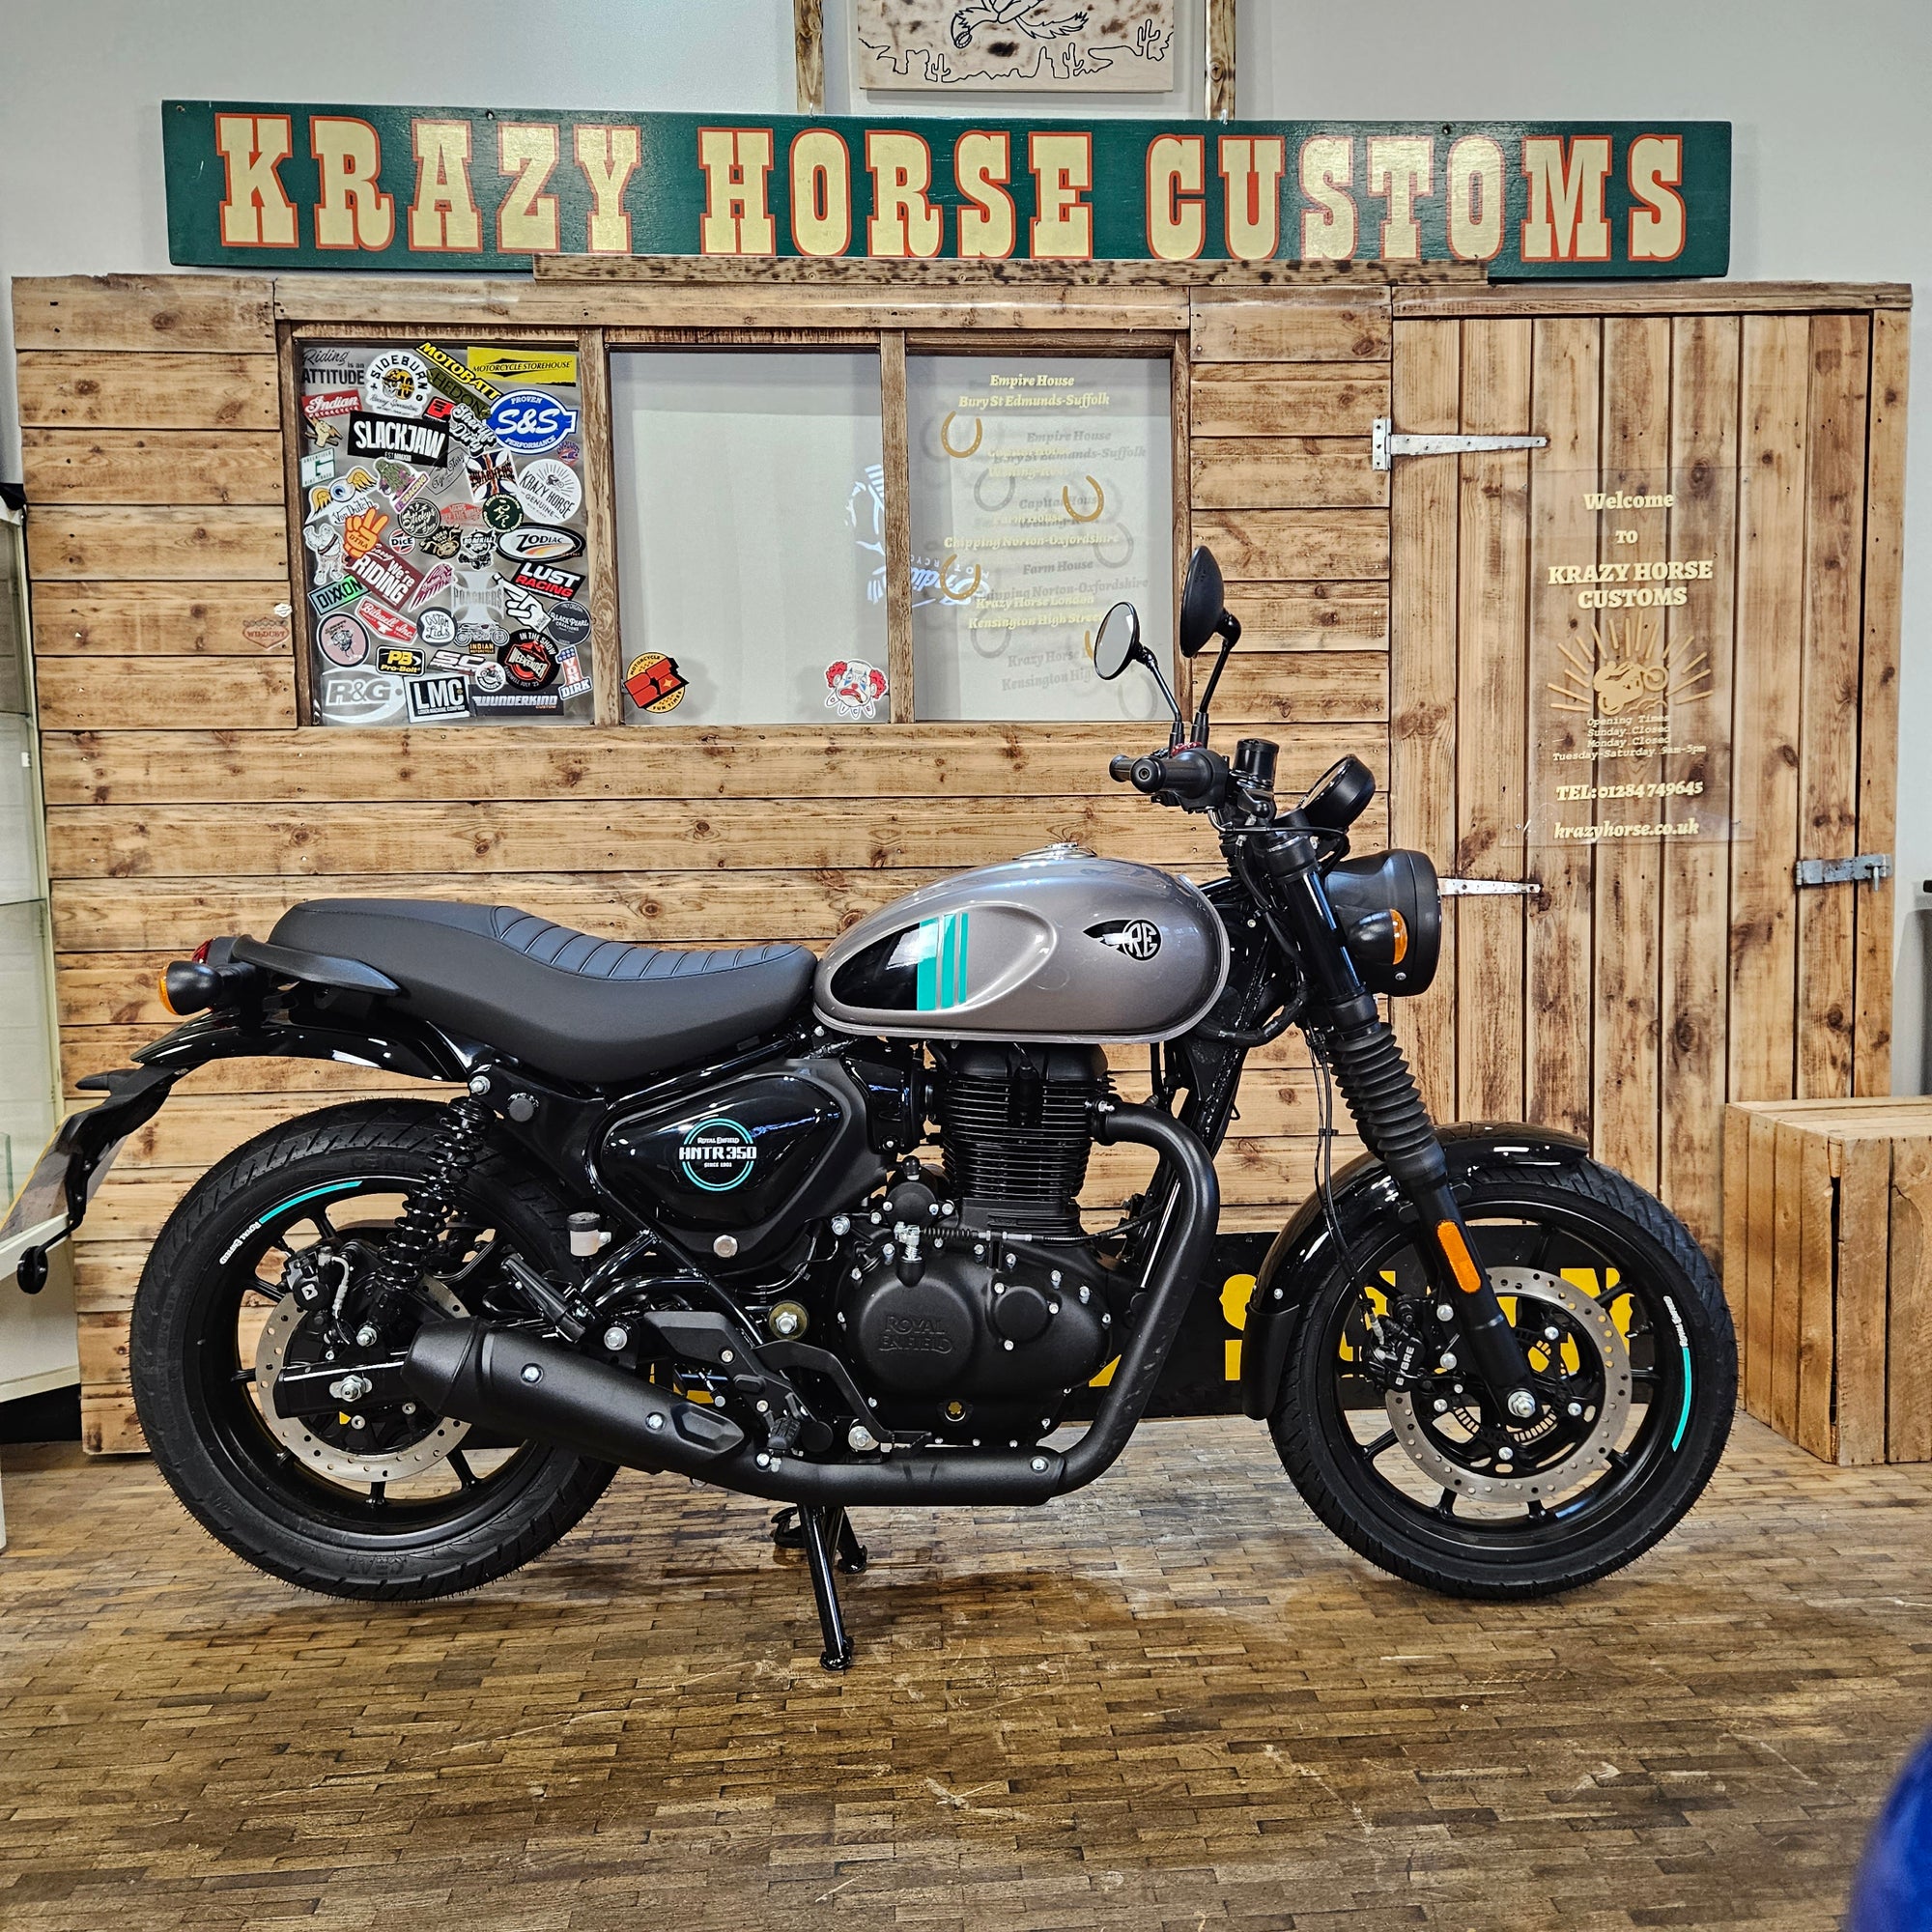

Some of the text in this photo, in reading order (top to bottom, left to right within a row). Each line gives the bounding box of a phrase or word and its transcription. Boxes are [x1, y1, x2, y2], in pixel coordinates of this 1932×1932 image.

[214, 112, 1686, 263] KRAZY HORSE CUSTOMS
[301, 348, 350, 366] Riding
[473, 360, 572, 373] MOTORCYCLE STOREHOUSE
[301, 368, 365, 384] ATTITUDE
[371, 355, 428, 390] SIDEBURN
[419, 342, 501, 400] MOTOBATT
[989, 374, 1074, 389] Empire House
[305, 394, 359, 413] Indian
[432, 372, 484, 418] HEDON
[511, 396, 542, 405] PROVEN
[958, 392, 1110, 410] Bury St Edmunds-Suffolk
[496, 408, 560, 435] S&S
[354, 420, 446, 459] SLACKJAW
[504, 435, 556, 449] PERFORMANCE
[520, 470, 547, 496] KRAZY
[548, 491, 575, 519] HORSE
[1583, 491, 1674, 510] Welcome
[348, 497, 374, 515] Dutch
[526, 495, 554, 517] GENUINE
[349, 534, 368, 549] DTRA
[517, 534, 564, 553] ZODIAC
[944, 537, 1001, 551] Chipping
[1615, 530, 1638, 544] TO
[351, 554, 409, 605] RIDING
[387, 559, 415, 587] We're
[520, 562, 581, 587] LUST
[1548, 560, 1714, 584] KRAZY HORSE
[317, 579, 363, 609] DIXXON
[515, 576, 574, 597] RACING
[453, 584, 502, 610] POACHERS
[1577, 587, 1688, 609] CUSTOMS
[361, 603, 396, 623] Biltwell
[969, 615, 1037, 630] Kensington
[1037, 612, 1067, 626] High
[528, 633, 541, 641] THE
[542, 636, 556, 655] SHOW
[387, 650, 413, 666] PB
[508, 647, 549, 679] WEEKENDER
[631, 655, 661, 675] MOTORCYCLE
[381, 664, 418, 673] Pro-Bolt
[327, 679, 392, 704] R&G
[414, 678, 464, 710] LMC
[560, 679, 591, 697] DIRK
[472, 696, 557, 706] WUNDERKIND
[1587, 715, 1669, 727] Opening Times
[1587, 725, 1670, 737] Sunday Closed
[1587, 736, 1670, 749] Monday Closed
[1552, 748, 1656, 761] Tuesday-Saturday
[1647, 781, 1704, 798] 749645
[1554, 818, 1699, 840] krazyhorse.co.uk
[679, 1146, 757, 1160] HNTR 350
[886, 1314, 946, 1335] ROYAL
[878, 1335, 953, 1353] ENFIELD
